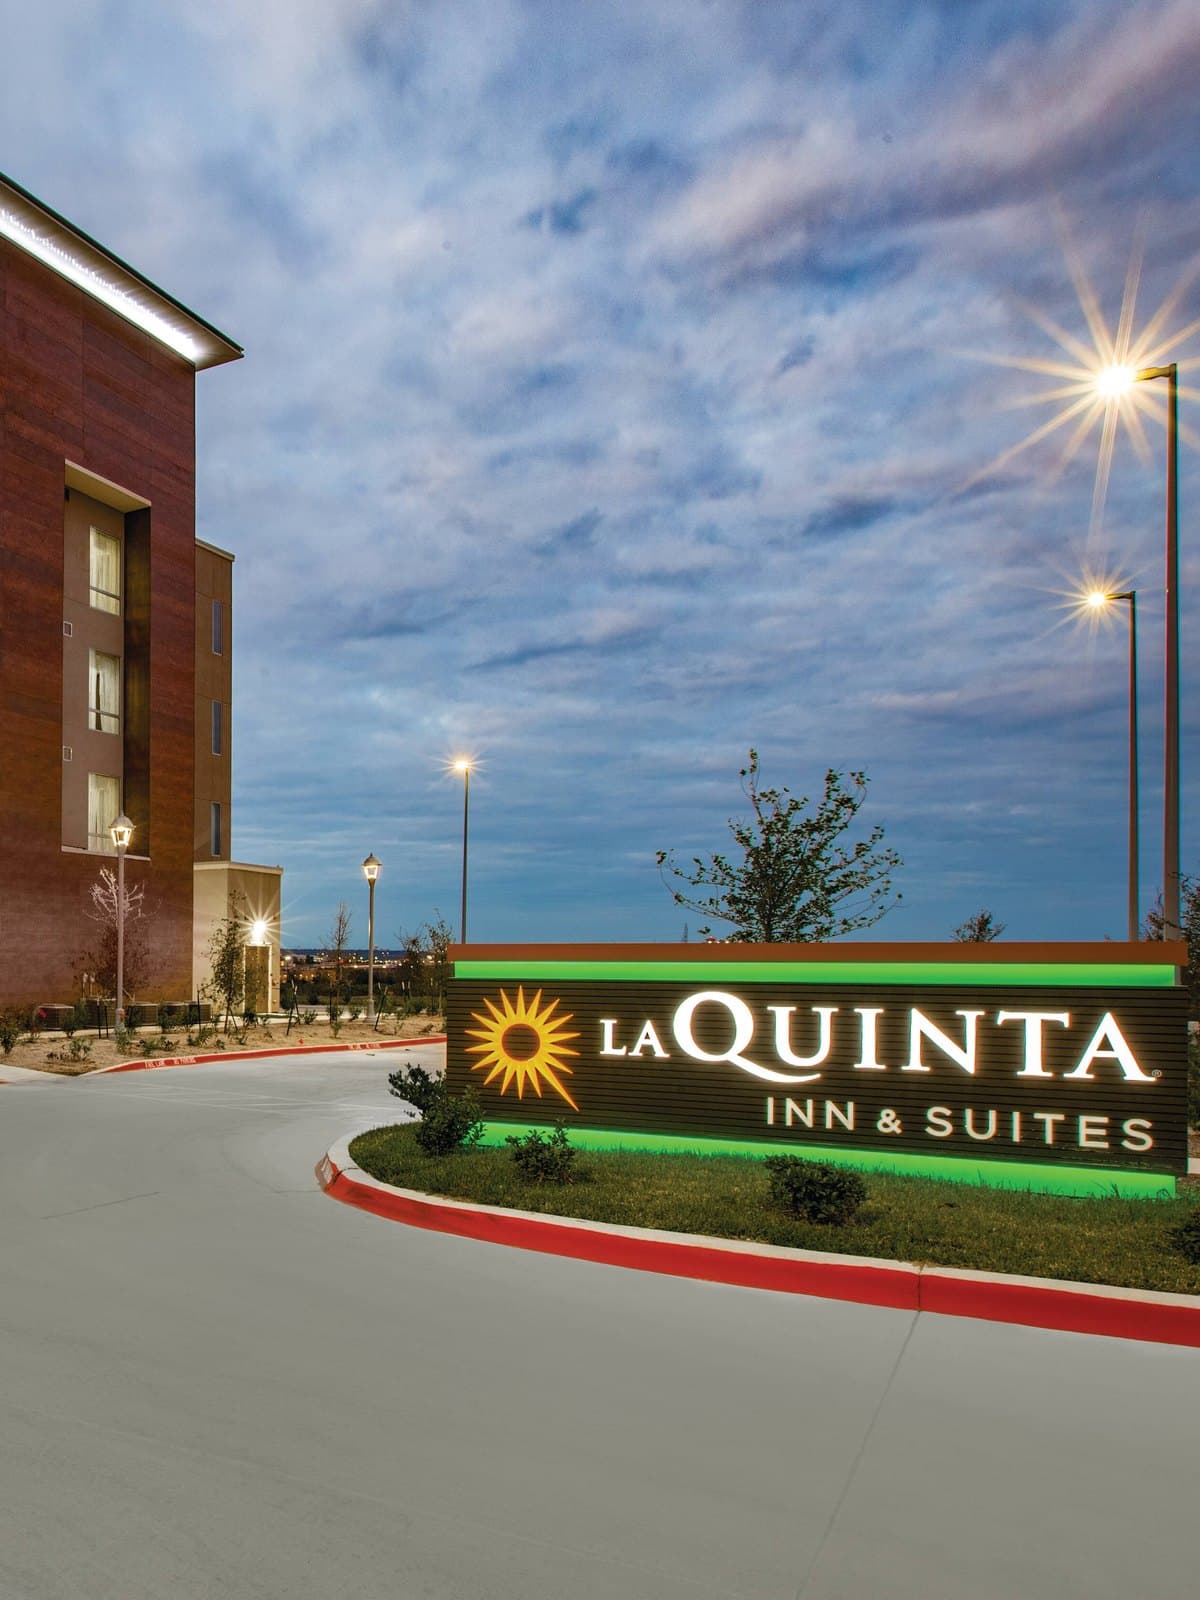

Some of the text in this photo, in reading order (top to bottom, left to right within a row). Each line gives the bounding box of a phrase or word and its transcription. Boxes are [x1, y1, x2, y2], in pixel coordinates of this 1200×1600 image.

[599, 991, 1156, 1083] LA QUINTA
[767, 1096, 1154, 1151] INN & SUITES
